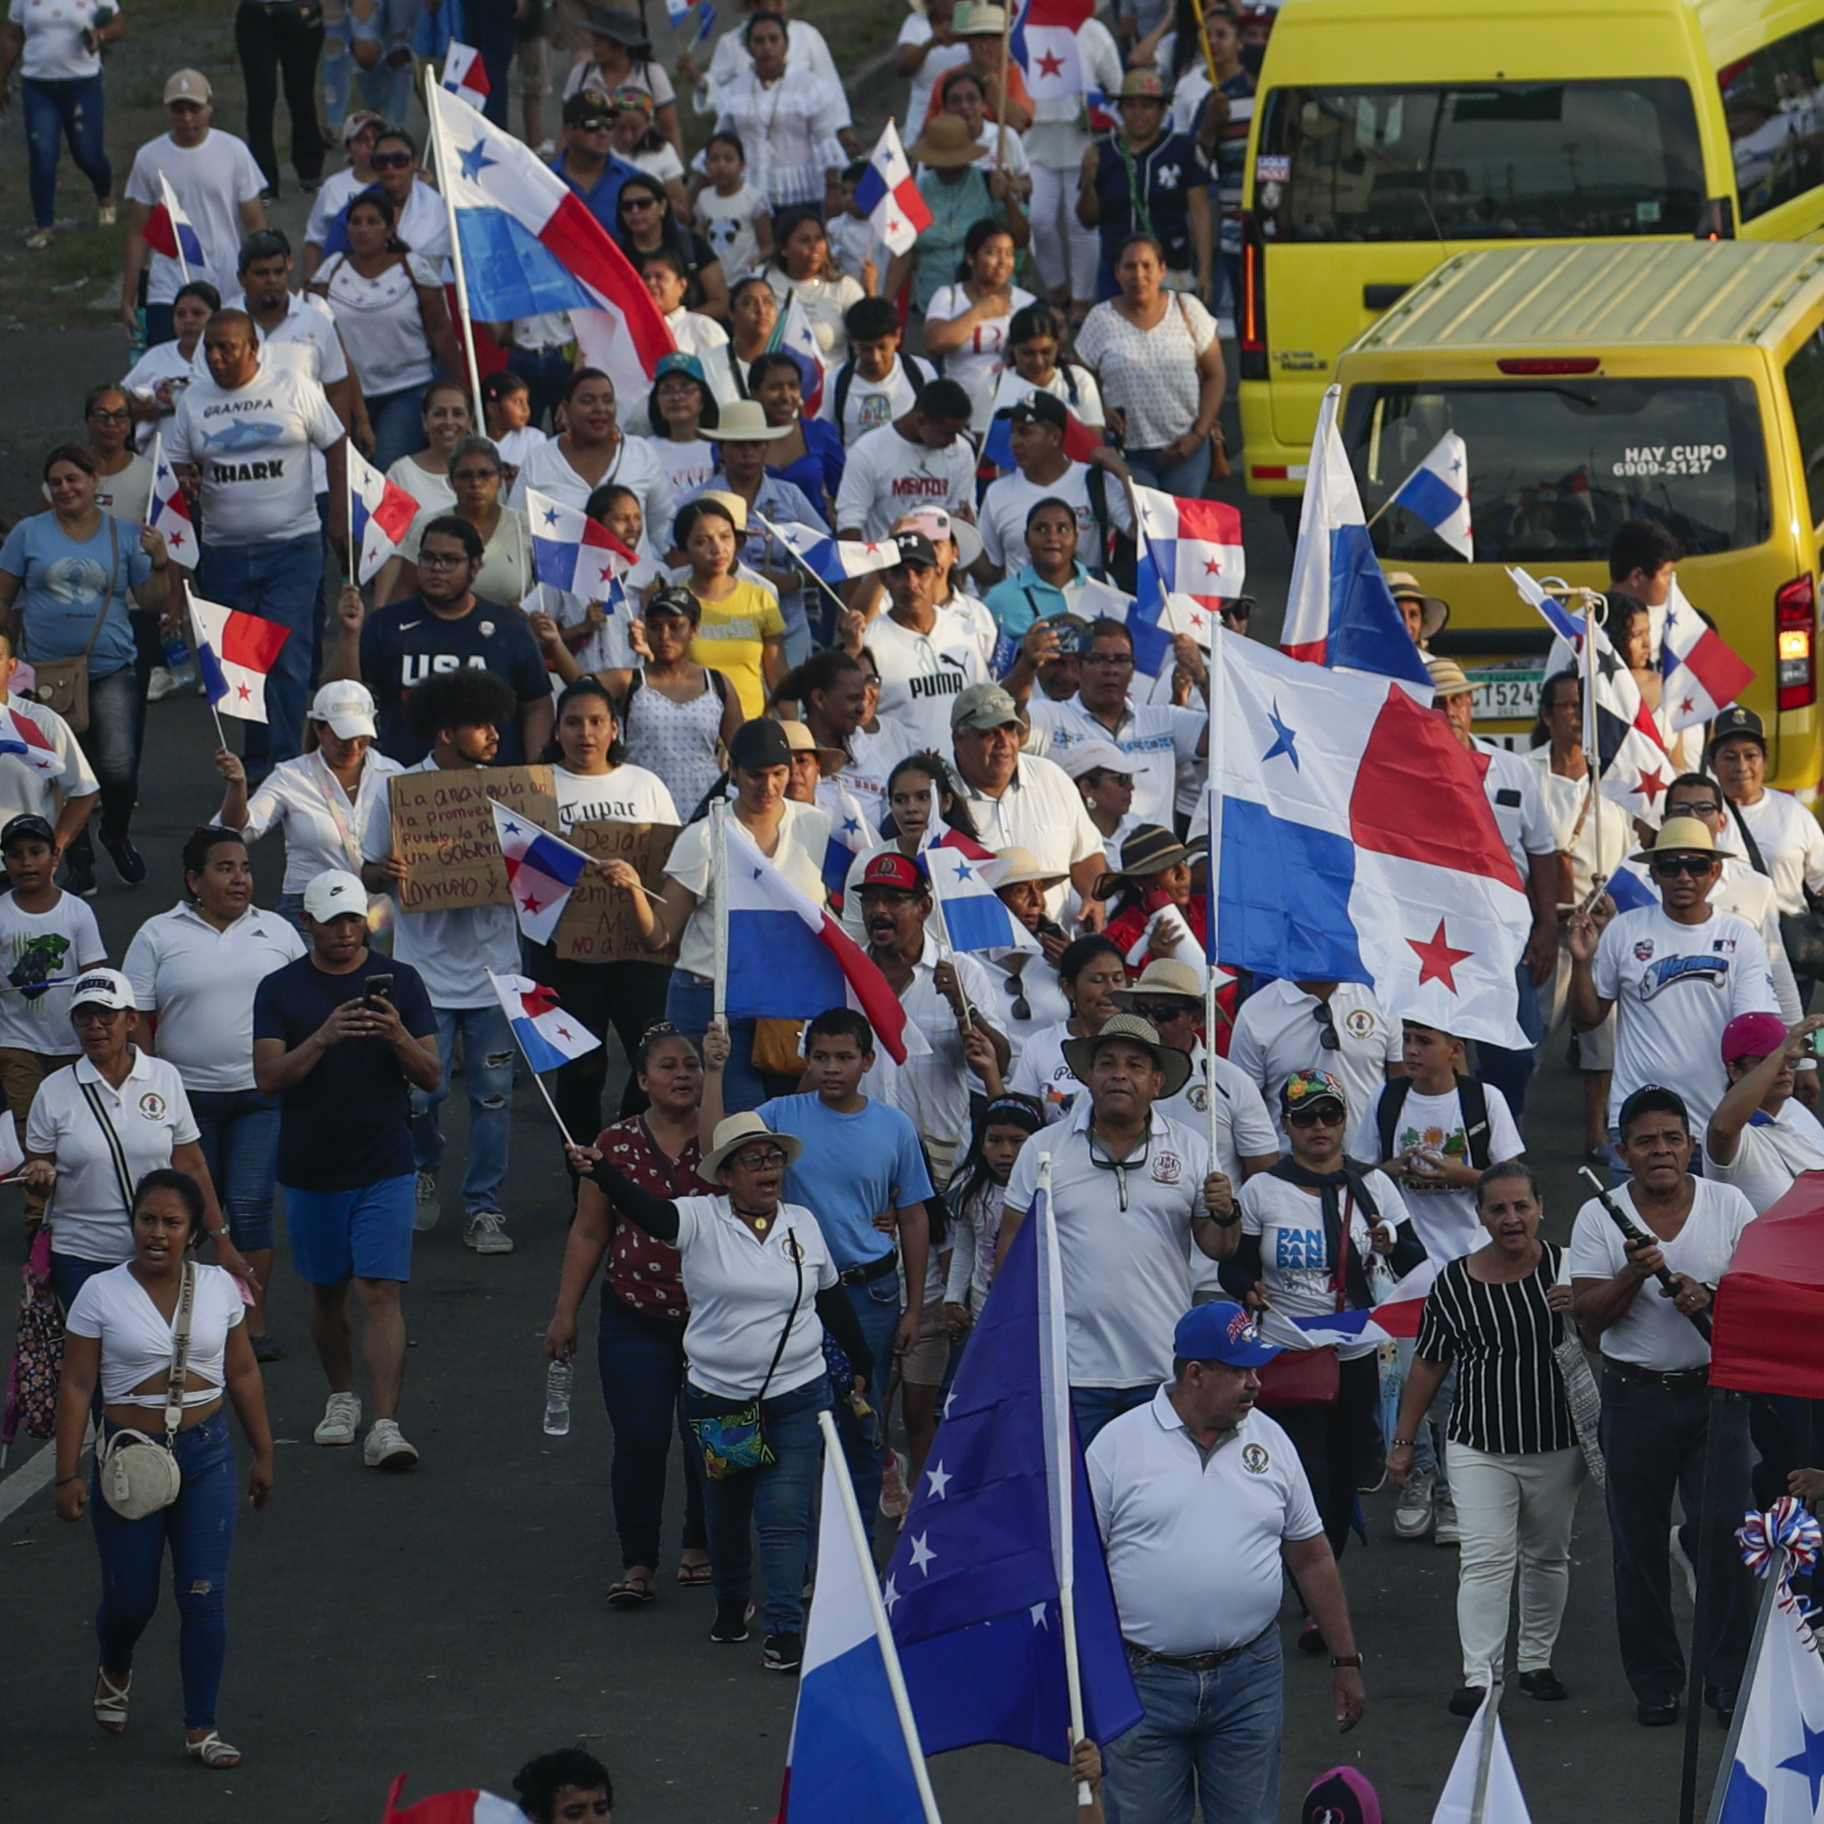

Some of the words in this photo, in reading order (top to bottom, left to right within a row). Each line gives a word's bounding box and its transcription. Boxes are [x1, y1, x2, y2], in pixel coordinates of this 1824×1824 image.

[203, 398, 275, 419] GRANDPA
[1625, 447, 1666, 463] HAY
[1671, 445, 1728, 461] CUPO
[213, 460, 285, 484] SHARK
[1612, 460, 1712, 477] 6909-2127
[402, 654, 489, 687] USA
[908, 672, 963, 700] PUMA
[398, 787, 428, 808] La
[1278, 1228, 1321, 1244] PAN
